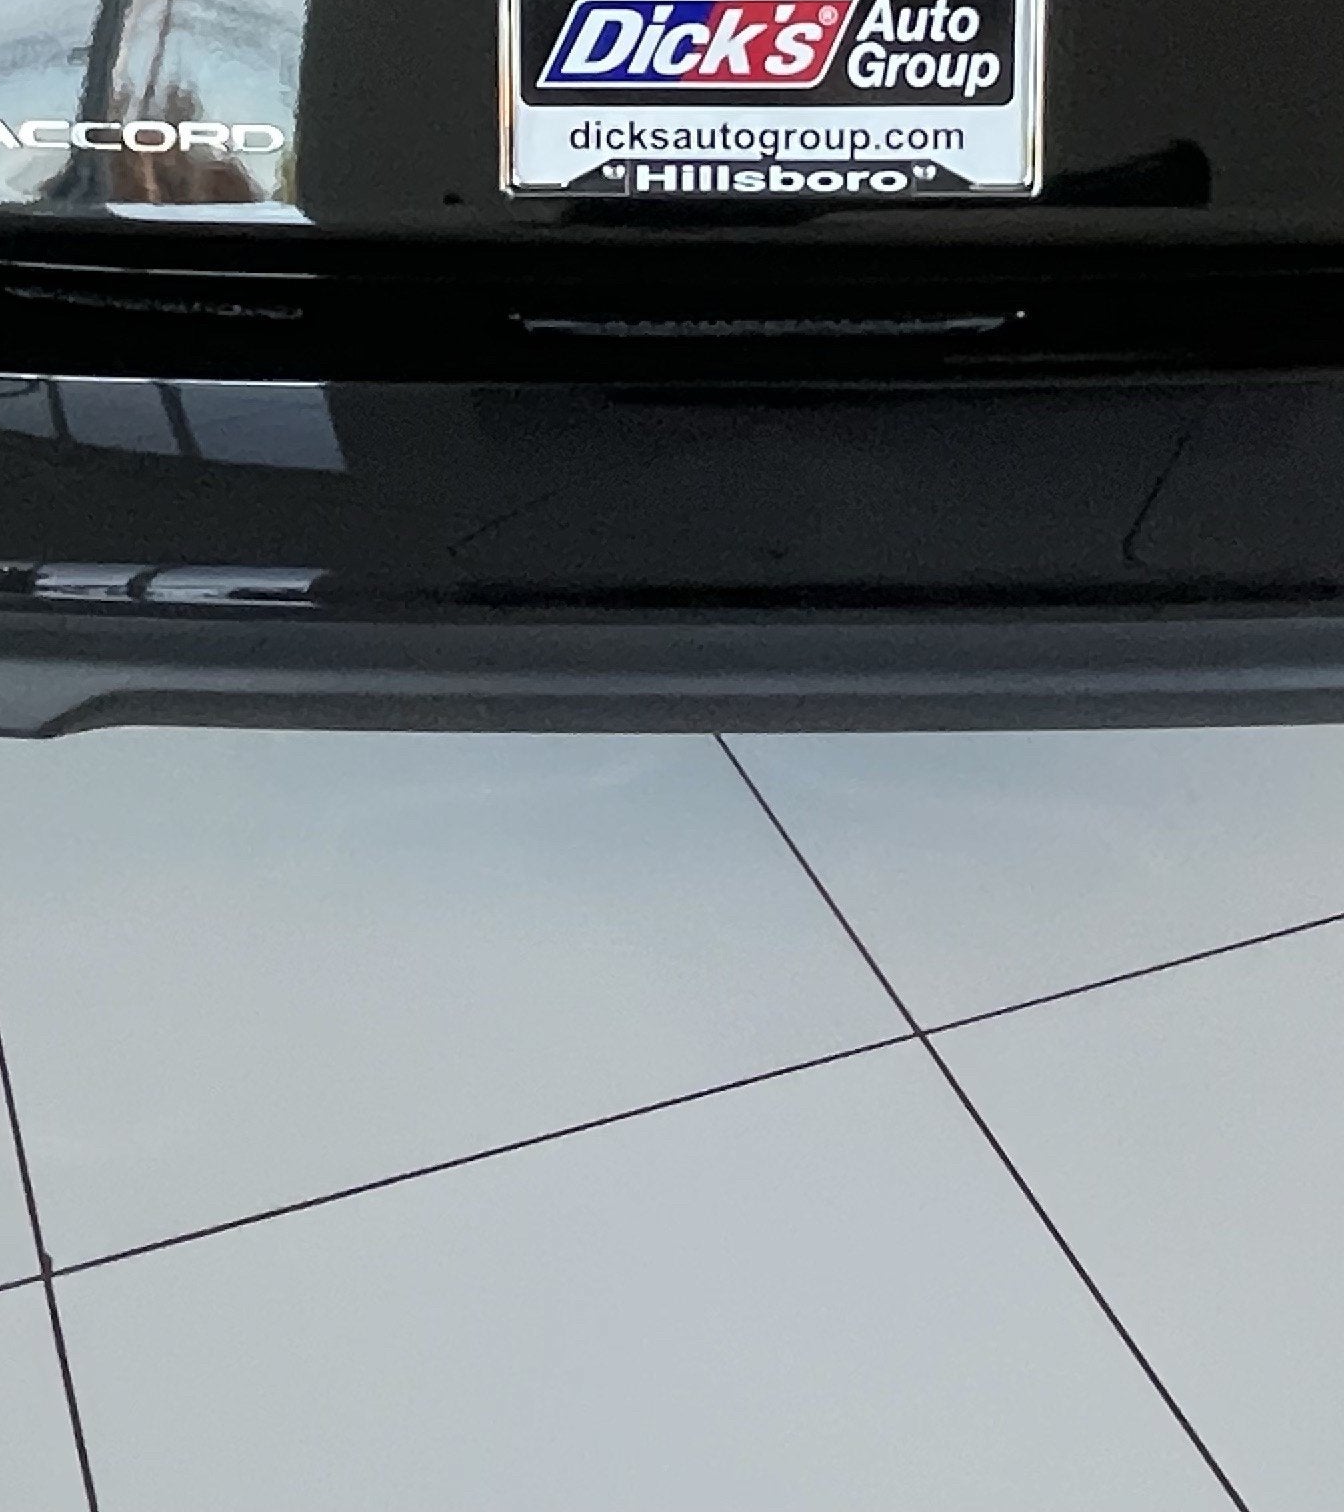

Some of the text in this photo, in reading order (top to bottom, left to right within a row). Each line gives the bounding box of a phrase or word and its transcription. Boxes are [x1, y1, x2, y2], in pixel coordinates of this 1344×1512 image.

[846, 41, 1001, 97] Group
[569, 120, 966, 158] dicksautogroup.com
[635, 164, 909, 193] Hillsboro
